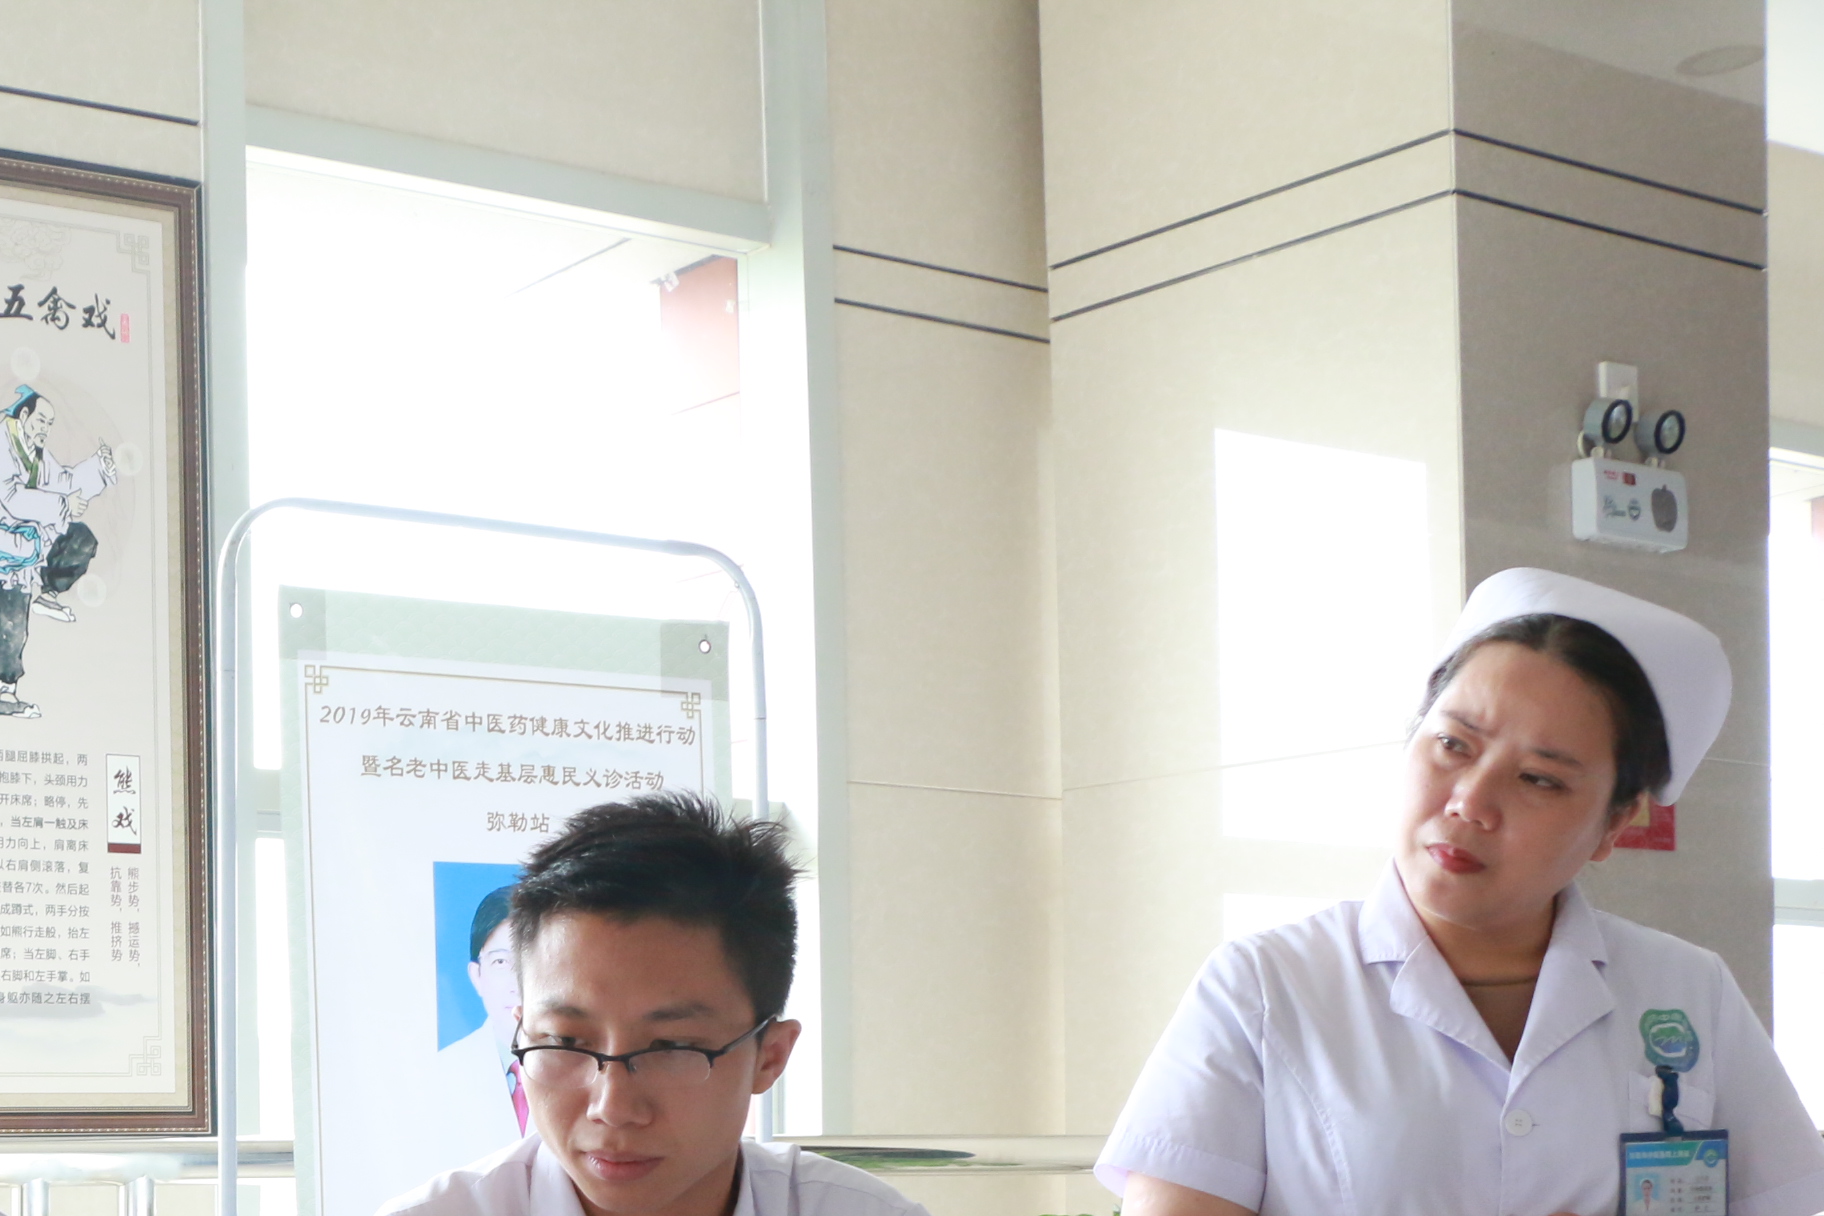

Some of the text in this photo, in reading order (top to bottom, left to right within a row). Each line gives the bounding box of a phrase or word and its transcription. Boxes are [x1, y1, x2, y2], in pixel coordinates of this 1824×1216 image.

[319, 704, 696, 746] 2019年云南省中医药健康文化推进行动
[360, 754, 665, 791] 暨名老中医走基层惠民义诊活动
[111, 766, 138, 836] 熊戏
[486, 810, 550, 834] 弥勒站
